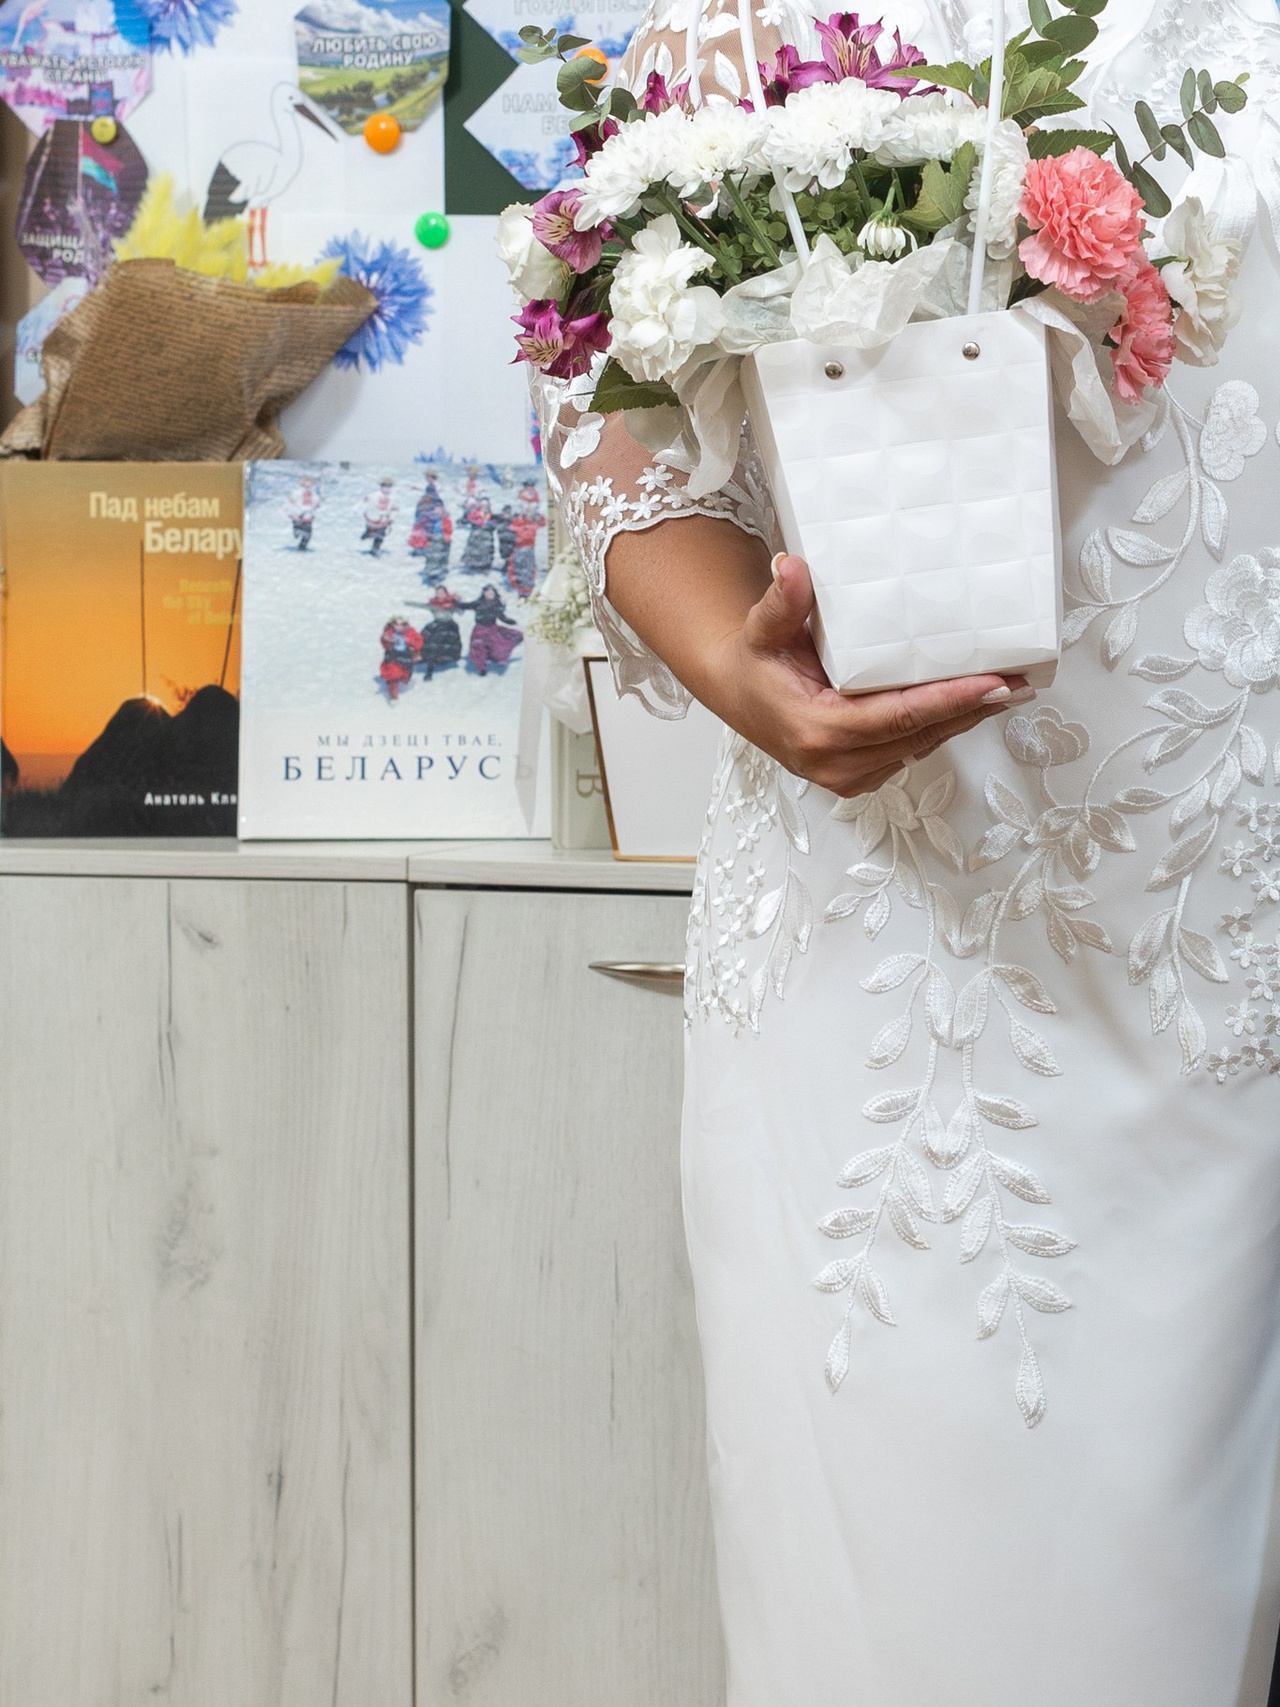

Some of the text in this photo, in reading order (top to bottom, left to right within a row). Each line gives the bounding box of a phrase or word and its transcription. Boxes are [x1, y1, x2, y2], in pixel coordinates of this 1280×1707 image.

[311, 32, 438, 54] ЛЮБИТЬ СВОЮ
[343, 51, 415, 70] РОДИНУ
[89, 491, 221, 523] Пад небам
[317, 733, 350, 748] МЫ
[144, 791, 205, 806] Анатоль
